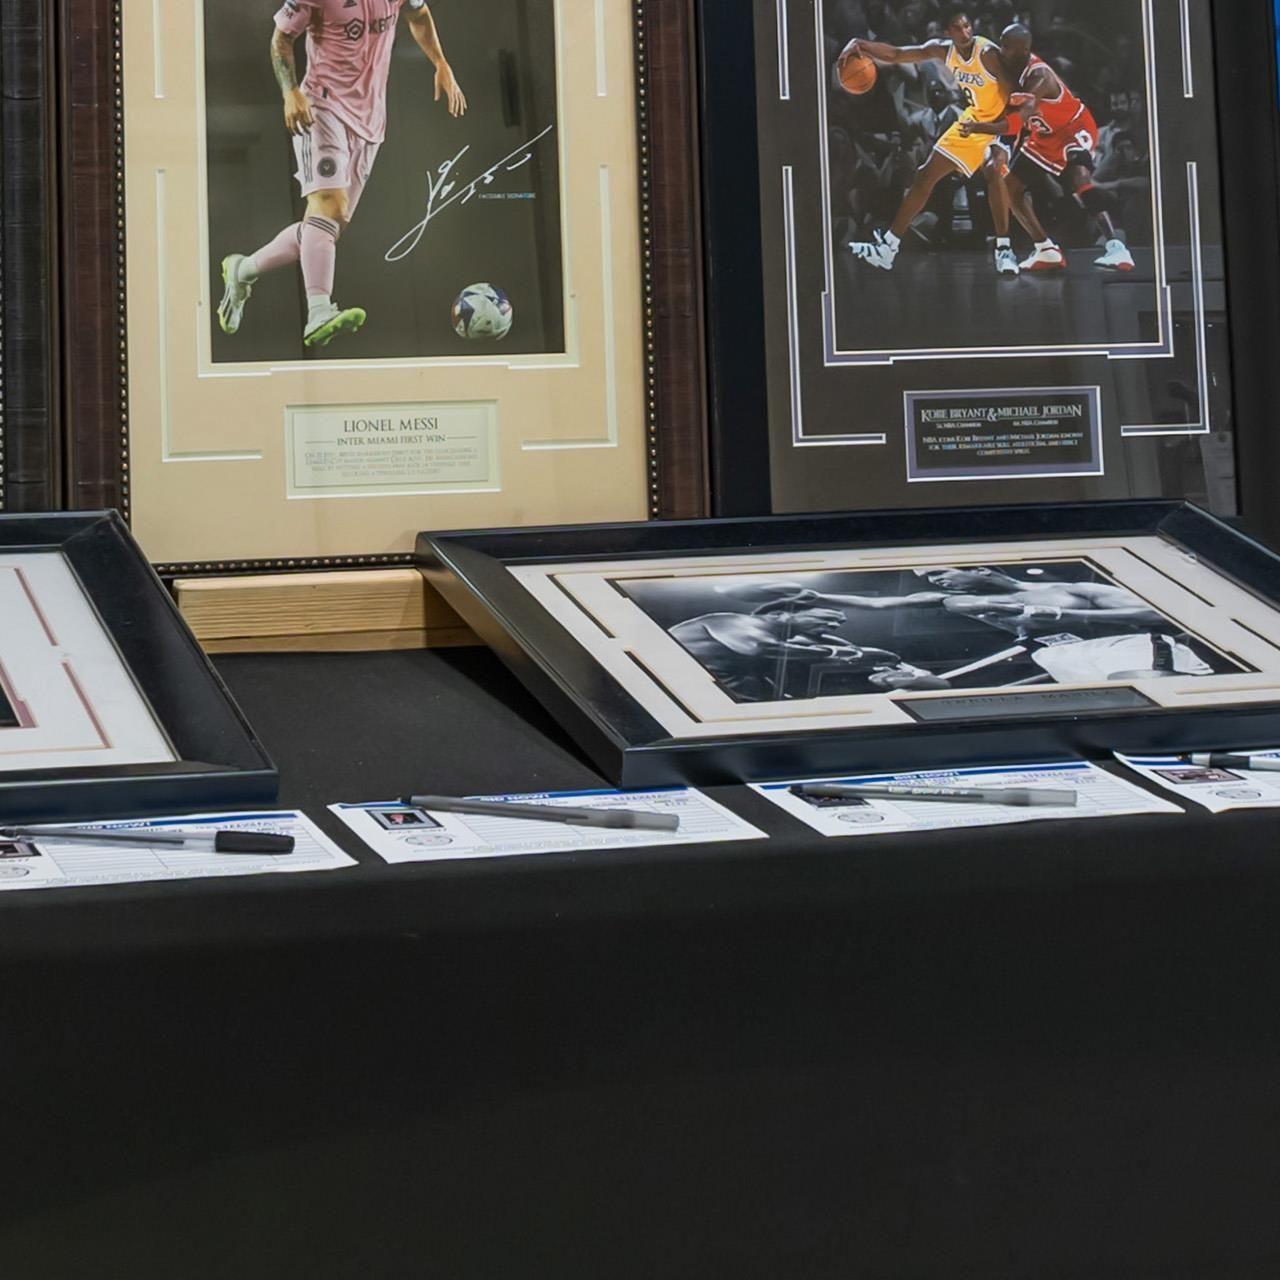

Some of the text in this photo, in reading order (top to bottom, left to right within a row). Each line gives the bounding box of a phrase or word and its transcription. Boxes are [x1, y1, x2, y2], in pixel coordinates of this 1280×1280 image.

[987, 407, 997, 422] &
[998, 406, 1039, 417] MICHAEL
[1042, 404, 1082, 418] JORDAN
[344, 417, 438, 433] LIONEL MESSI
